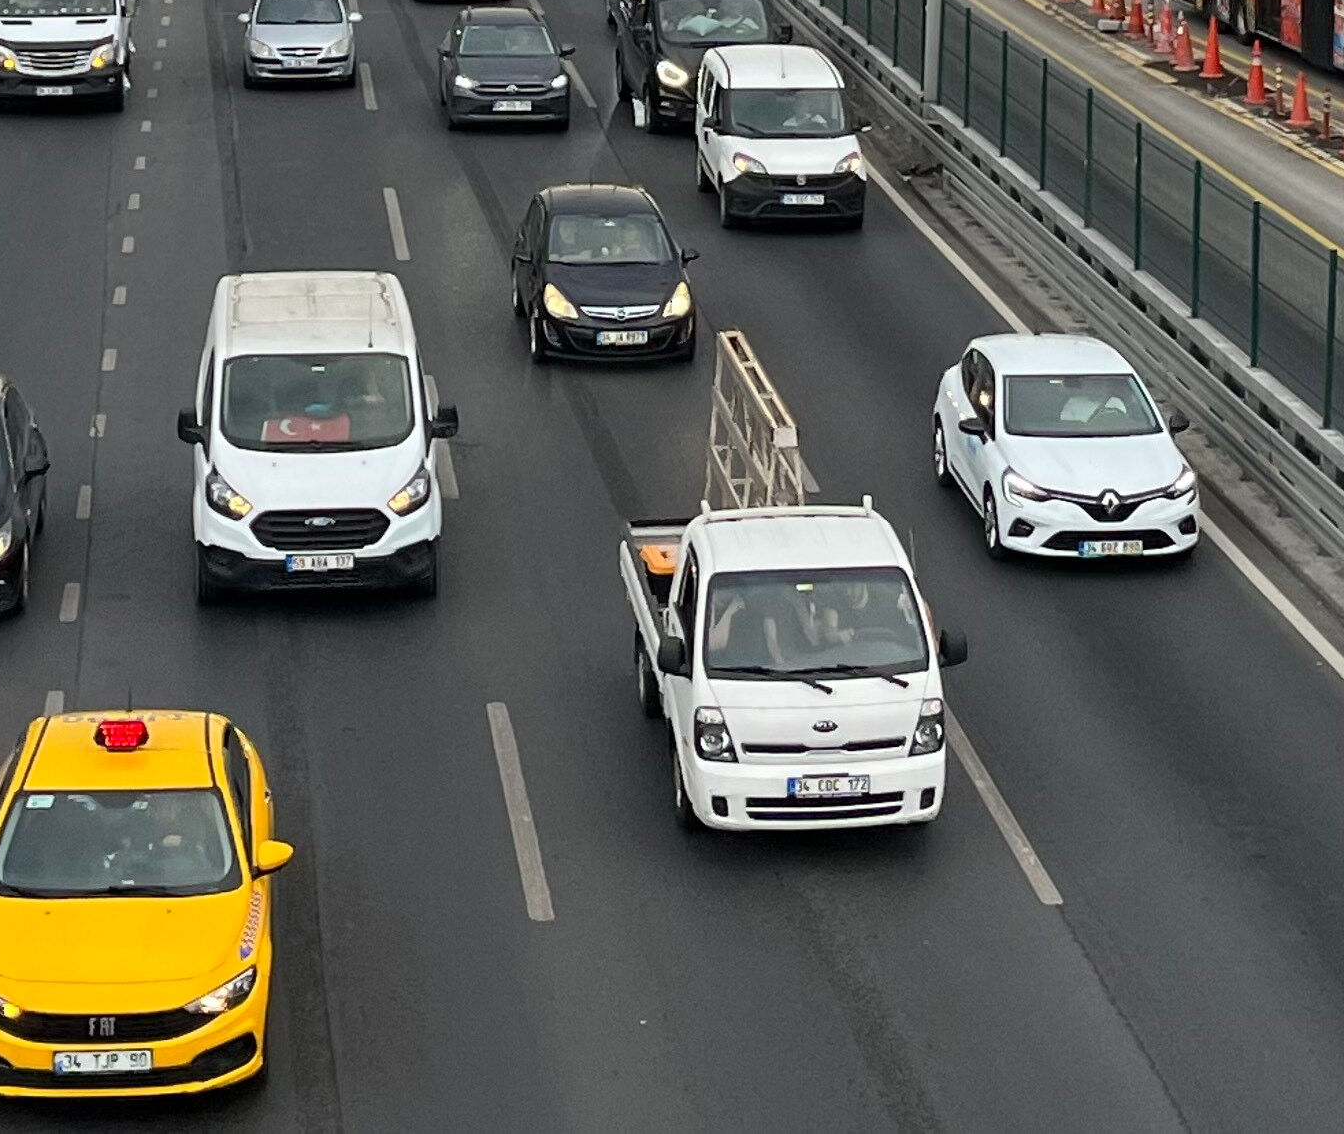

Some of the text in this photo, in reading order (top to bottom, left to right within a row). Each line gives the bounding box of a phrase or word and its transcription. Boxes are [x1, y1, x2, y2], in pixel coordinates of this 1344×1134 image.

[798, 780, 811, 792] 34
[848, 777, 868, 791] 172
[63, 1053, 148, 1069] 34 TJP 90
